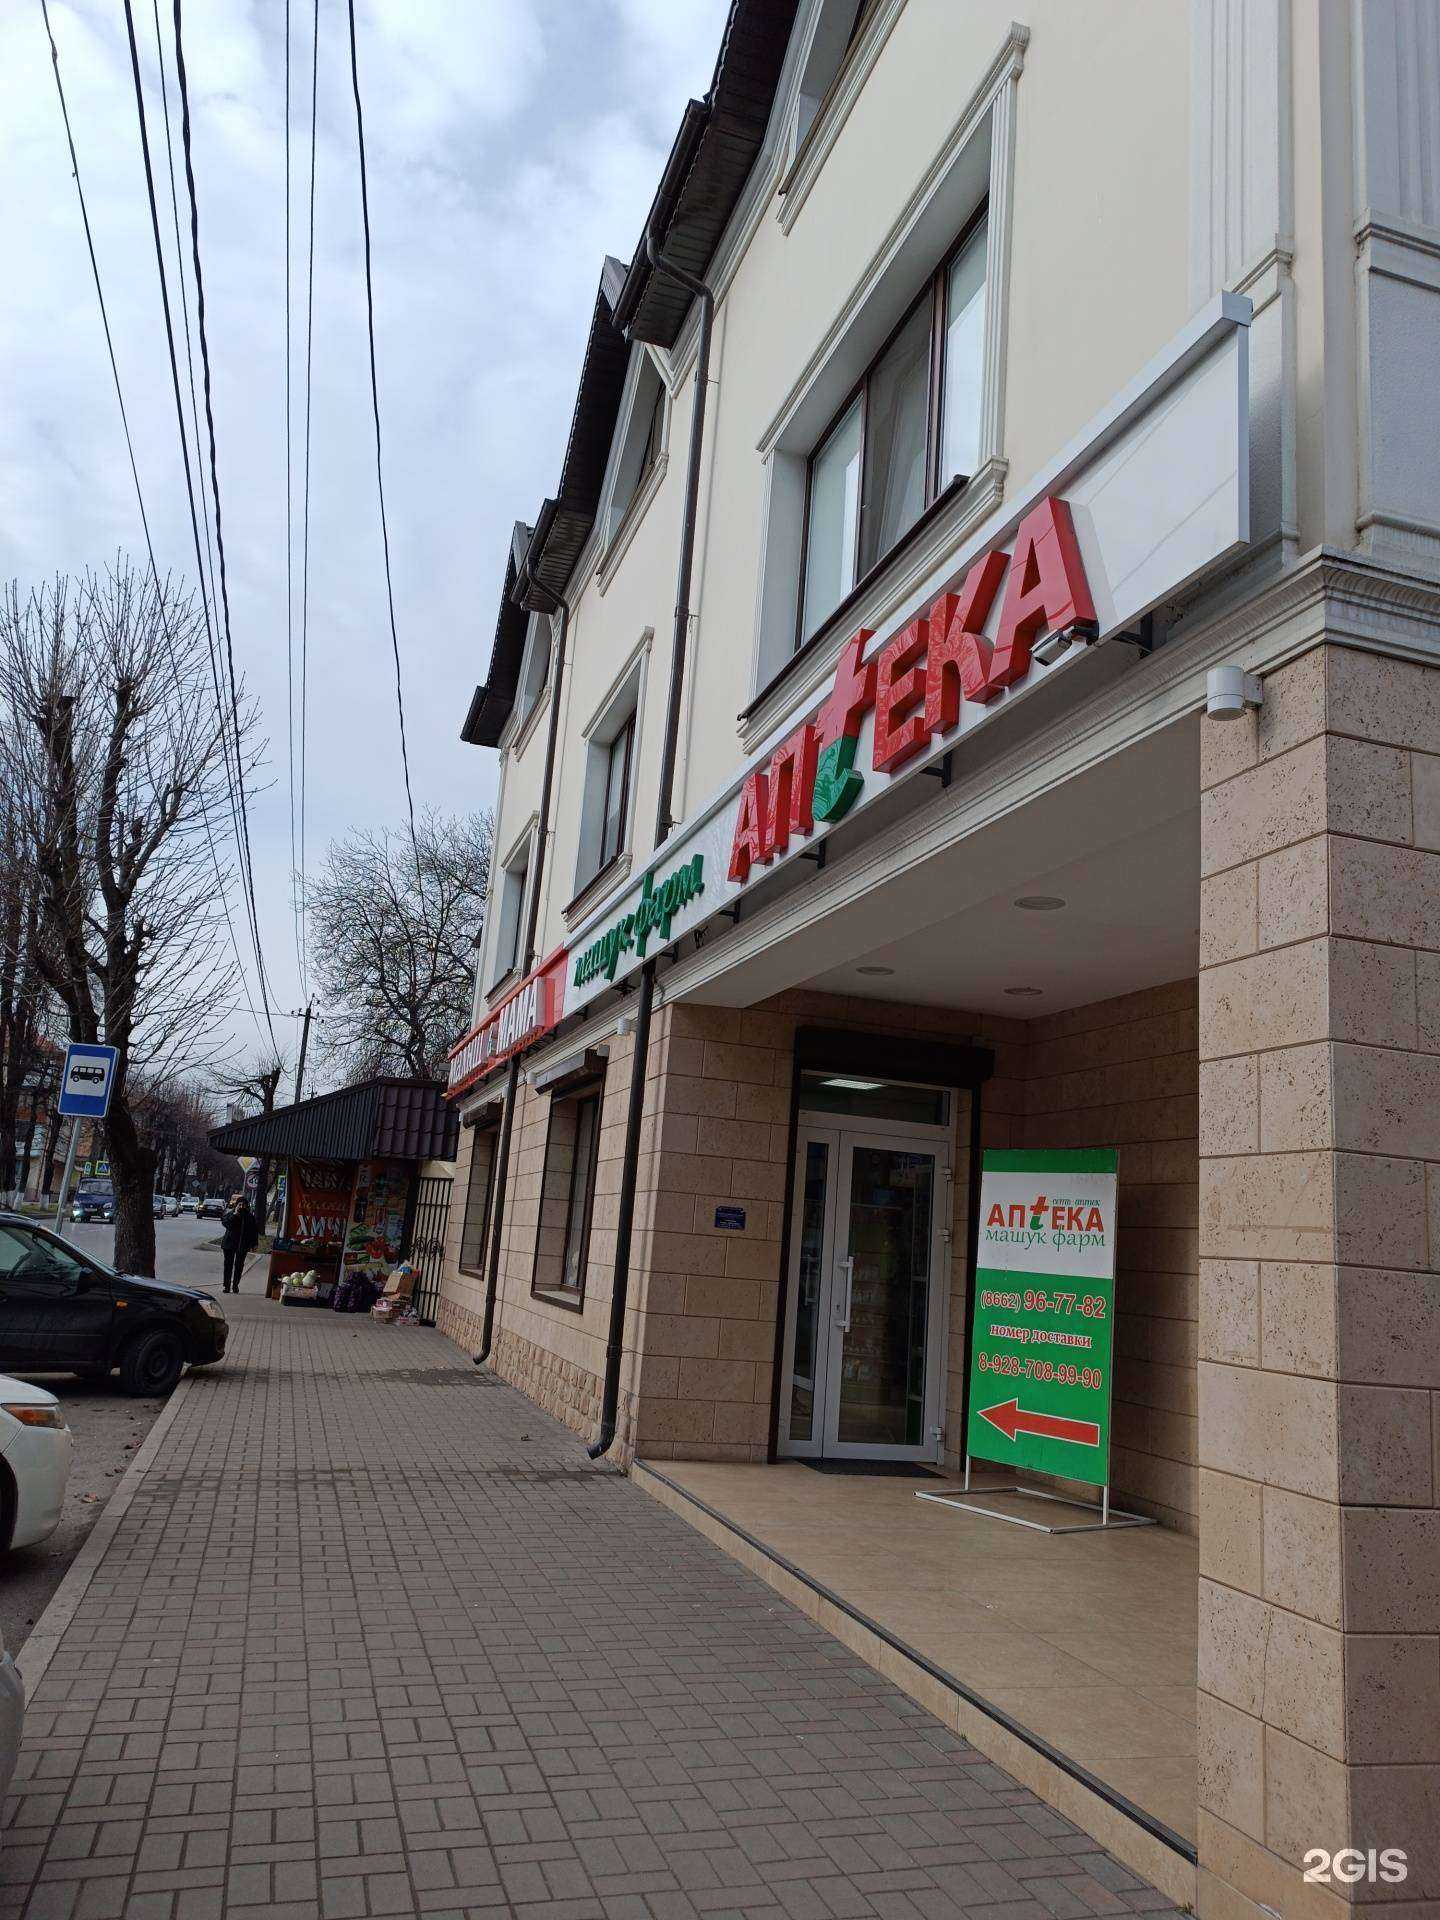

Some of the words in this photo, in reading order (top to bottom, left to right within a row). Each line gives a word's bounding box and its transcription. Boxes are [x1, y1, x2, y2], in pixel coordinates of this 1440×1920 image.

[633, 853, 705, 958] фарм
[985, 1229, 1047, 1250] машук
[1052, 1225, 1105, 1253] фарм
[980, 1289, 1021, 1314] (8662)
[1023, 1289, 1106, 1319] 96-77-82
[990, 1324, 1030, 1344] номер
[1031, 1329, 1093, 1349] доставки
[979, 1352, 1102, 1390] 8-928-708-99-90
